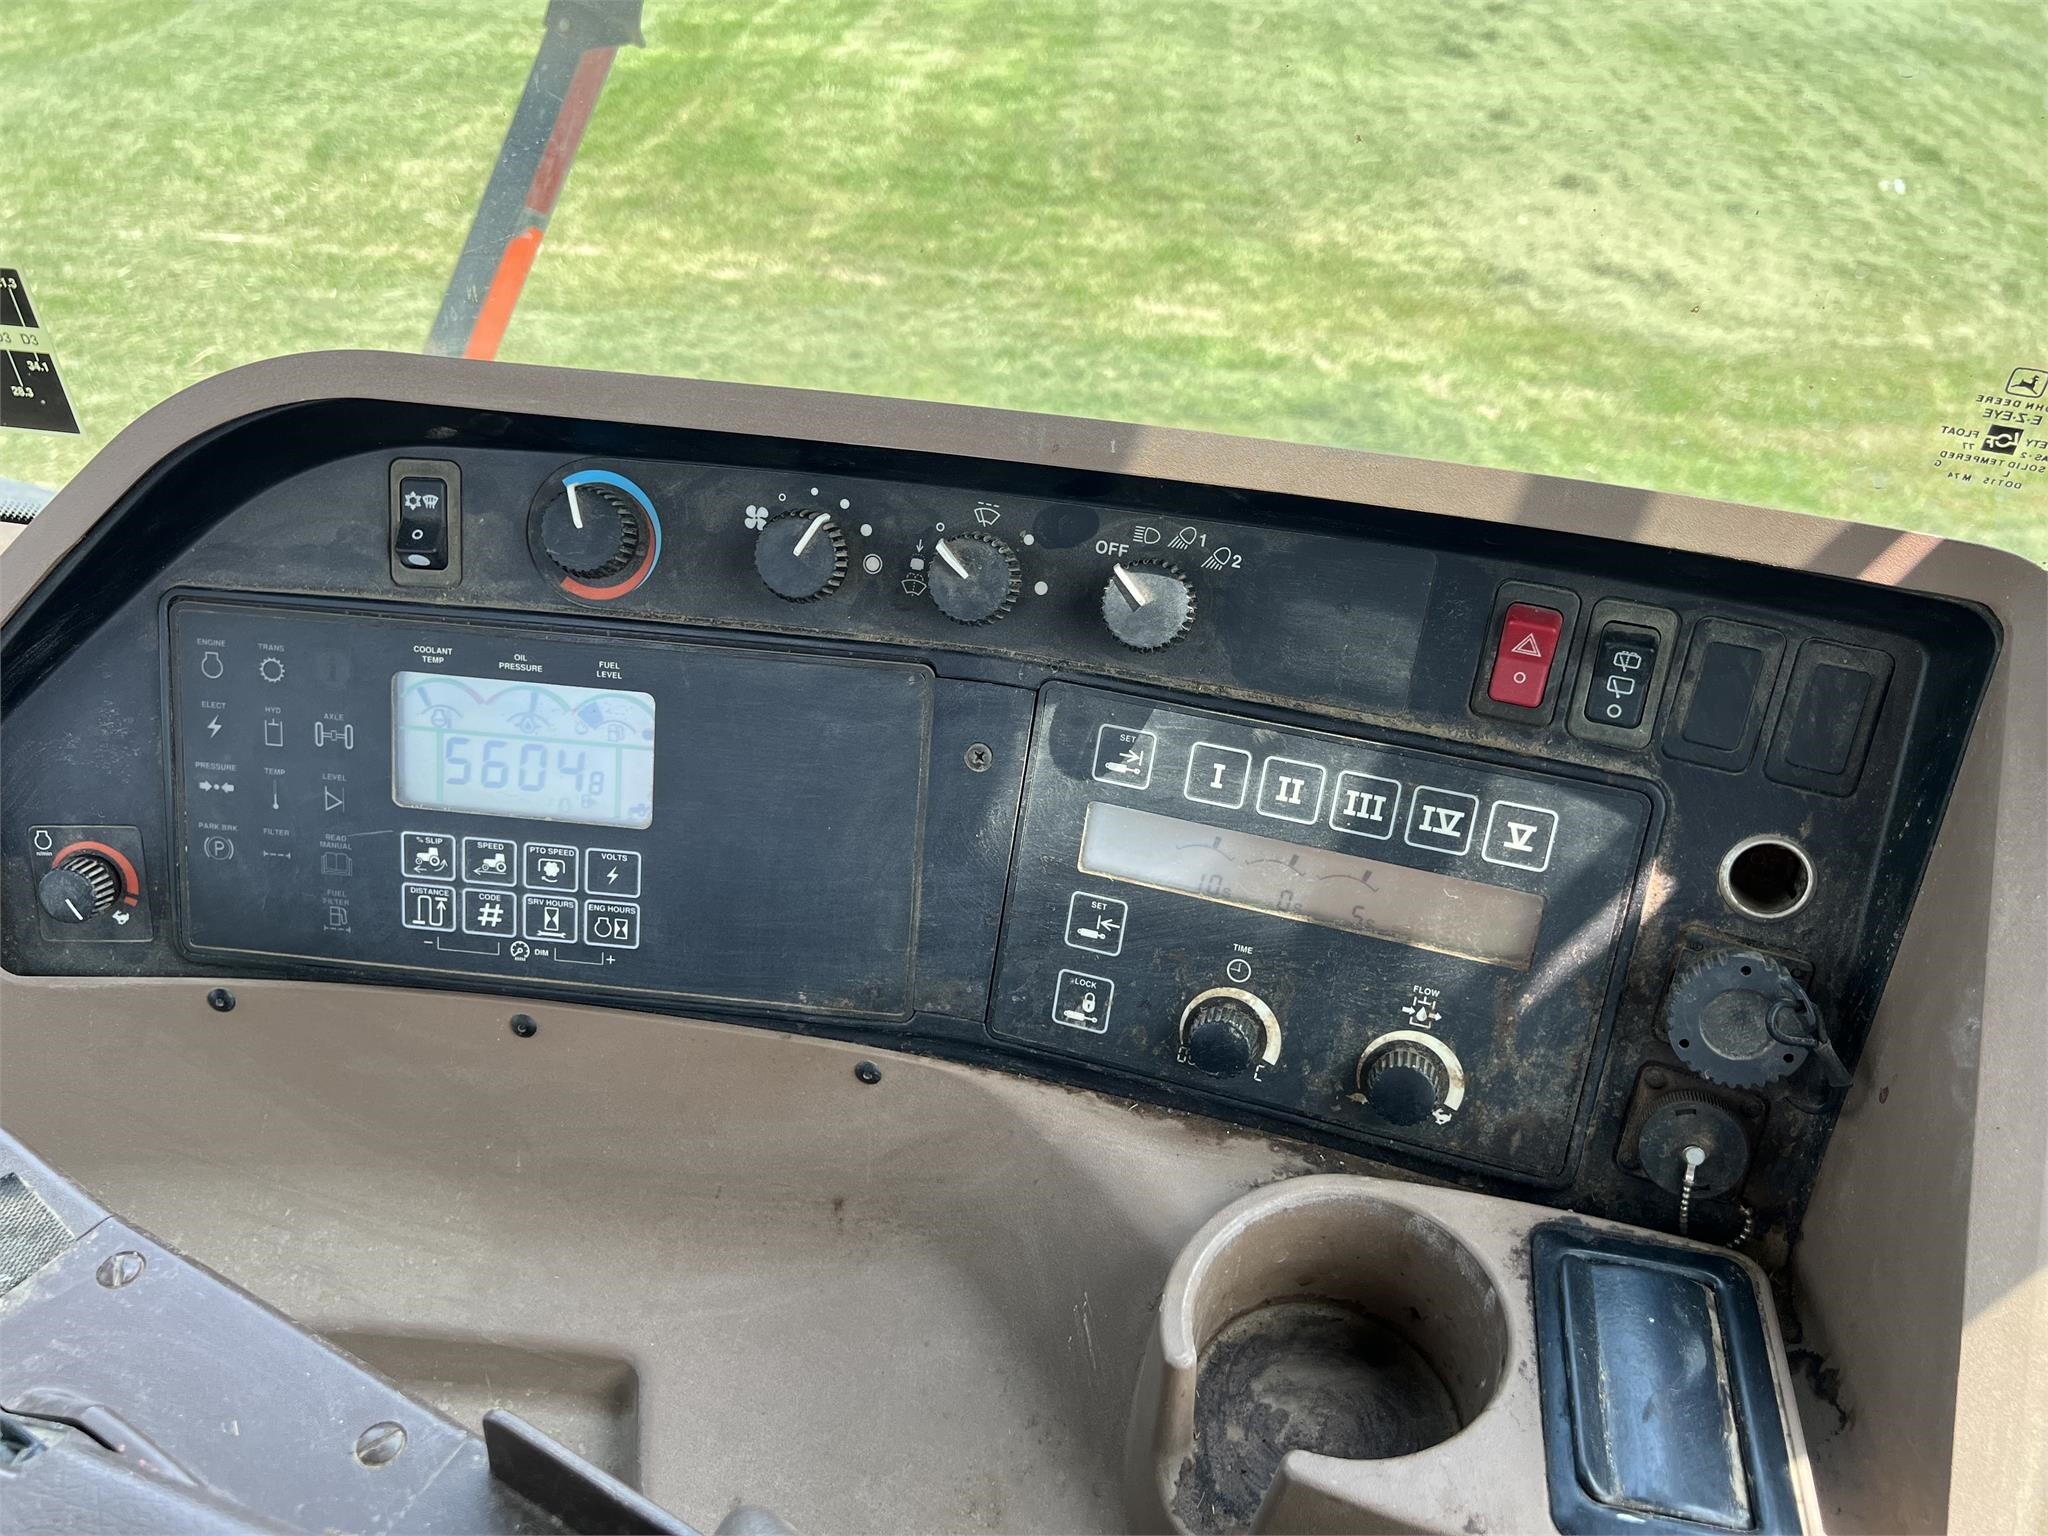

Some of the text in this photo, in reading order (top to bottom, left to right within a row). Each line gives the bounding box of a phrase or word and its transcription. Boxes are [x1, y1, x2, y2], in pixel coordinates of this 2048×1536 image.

[20, 333, 39, 345] D3
[26, 360, 50, 373] 34.1
[10, 385, 35, 398] 28.3
[1199, 533, 1208, 547] 1
[1095, 540, 1130, 557] OFF
[1231, 554, 1243, 569] 2
[196, 638, 226, 647] ENGINE
[257, 643, 285, 652] TRANS
[413, 645, 453, 656] COOLANT
[422, 656, 445, 664] TEMP
[514, 654, 528, 662] OIL
[498, 662, 543, 673] PRESSURE
[598, 661, 621, 670] FUEL
[596, 670, 623, 680] LEVEL
[201, 700, 227, 709] ELECT
[264, 706, 281, 714] HYD
[323, 713, 345, 721] AXLE
[1120, 733, 1137, 744] SET
[195, 761, 237, 771] PRESSURE
[264, 767, 286, 776] TEMP
[1210, 763, 1226, 789] I
[322, 773, 347, 781] LEVEL
[1275, 776, 1305, 805] II
[1343, 789, 1387, 822] III
[198, 822, 219, 830] PARK
[1419, 804, 1465, 838] IV
[263, 828, 290, 836] FILTER
[1503, 821, 1538, 853] V
[325, 834, 347, 842] READ
[416, 836, 443, 845] % SLIP
[320, 841, 352, 850] MANUAL
[477, 841, 505, 851] SPEED
[529, 846, 575, 858] PTO SPEED
[601, 852, 628, 862] VOLTS
[327, 889, 347, 897] FUEL
[410, 886, 450, 897] DISTANCE
[322, 898, 350, 906] FILTER
[478, 892, 501, 902] CODE
[527, 897, 575, 909] SRV HOURS
[1091, 901, 1108, 911] SET
[588, 904, 637, 915] ENG HOURS
[534, 948, 549, 957] DIM
[1233, 943, 1254, 955] TIME
[1074, 977, 1098, 990] LOCK
[1412, 984, 1441, 998] FLOW
